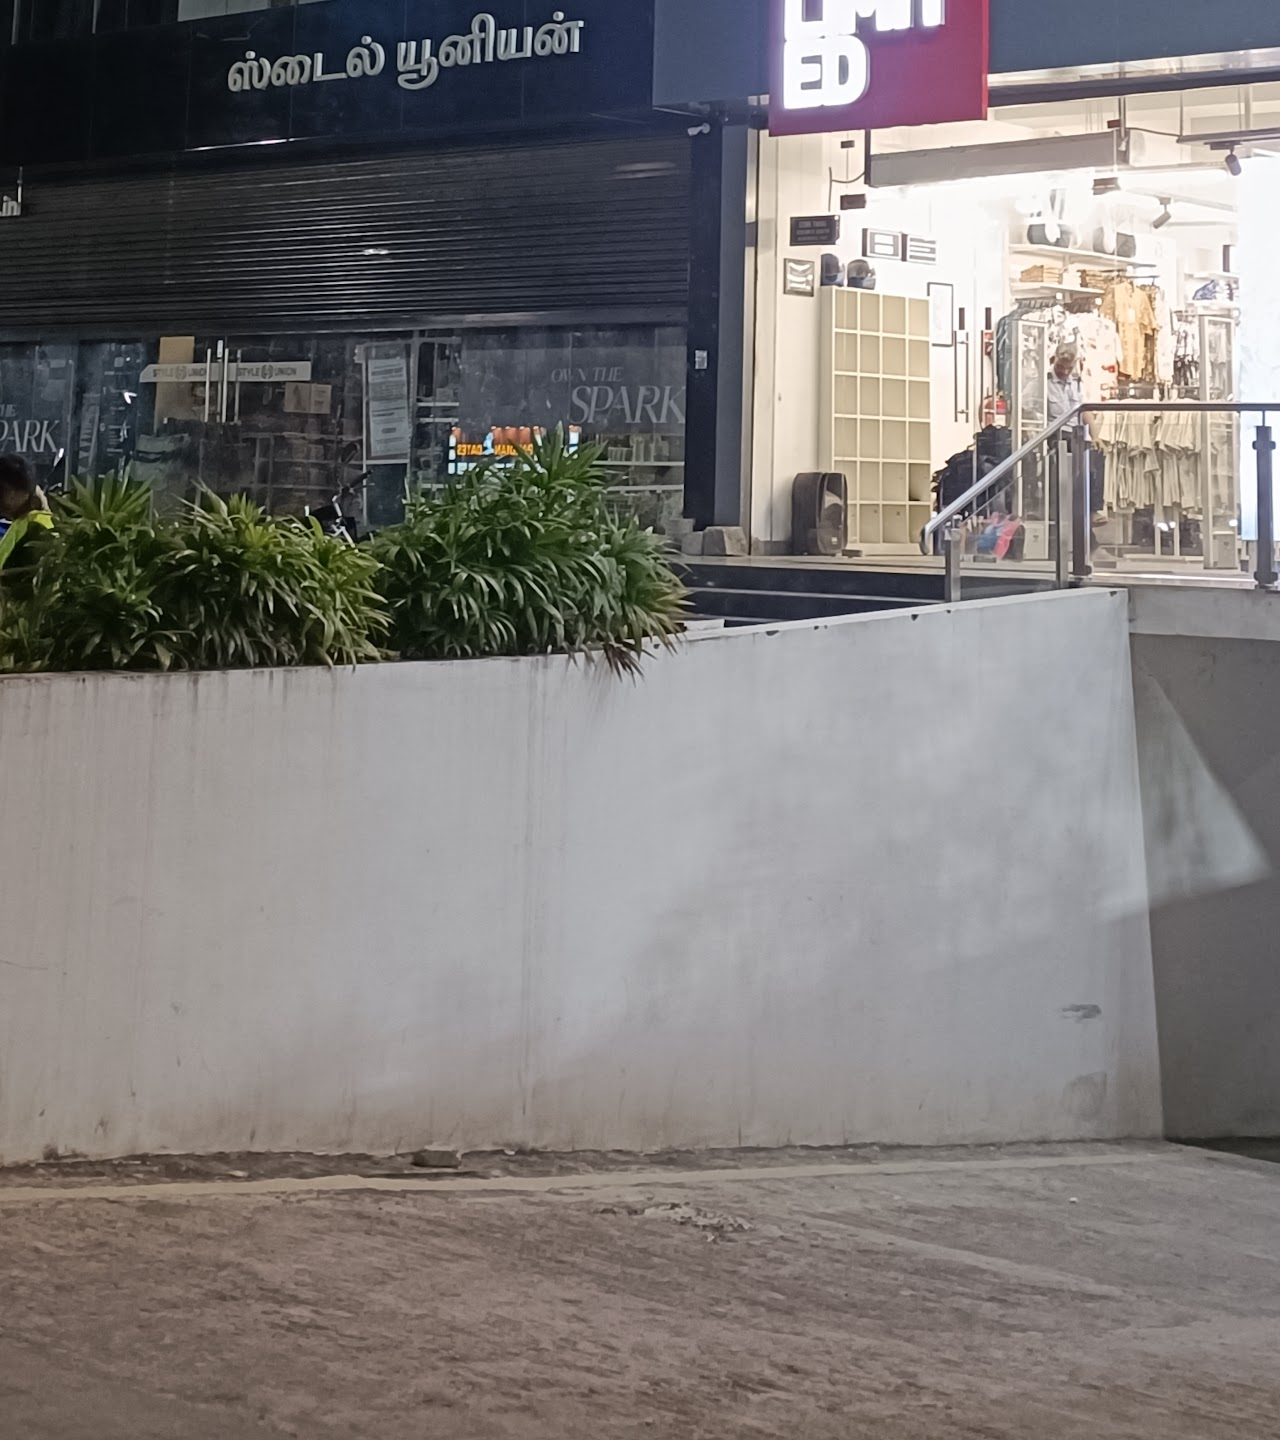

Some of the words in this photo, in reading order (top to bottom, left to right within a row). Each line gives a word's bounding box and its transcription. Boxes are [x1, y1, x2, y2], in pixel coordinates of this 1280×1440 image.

[396, 11, 584, 90] யூனியன்
[783, 34, 870, 109] ED
[188, 366, 209, 378] UNIO
[571, 385, 687, 424] SPARK
